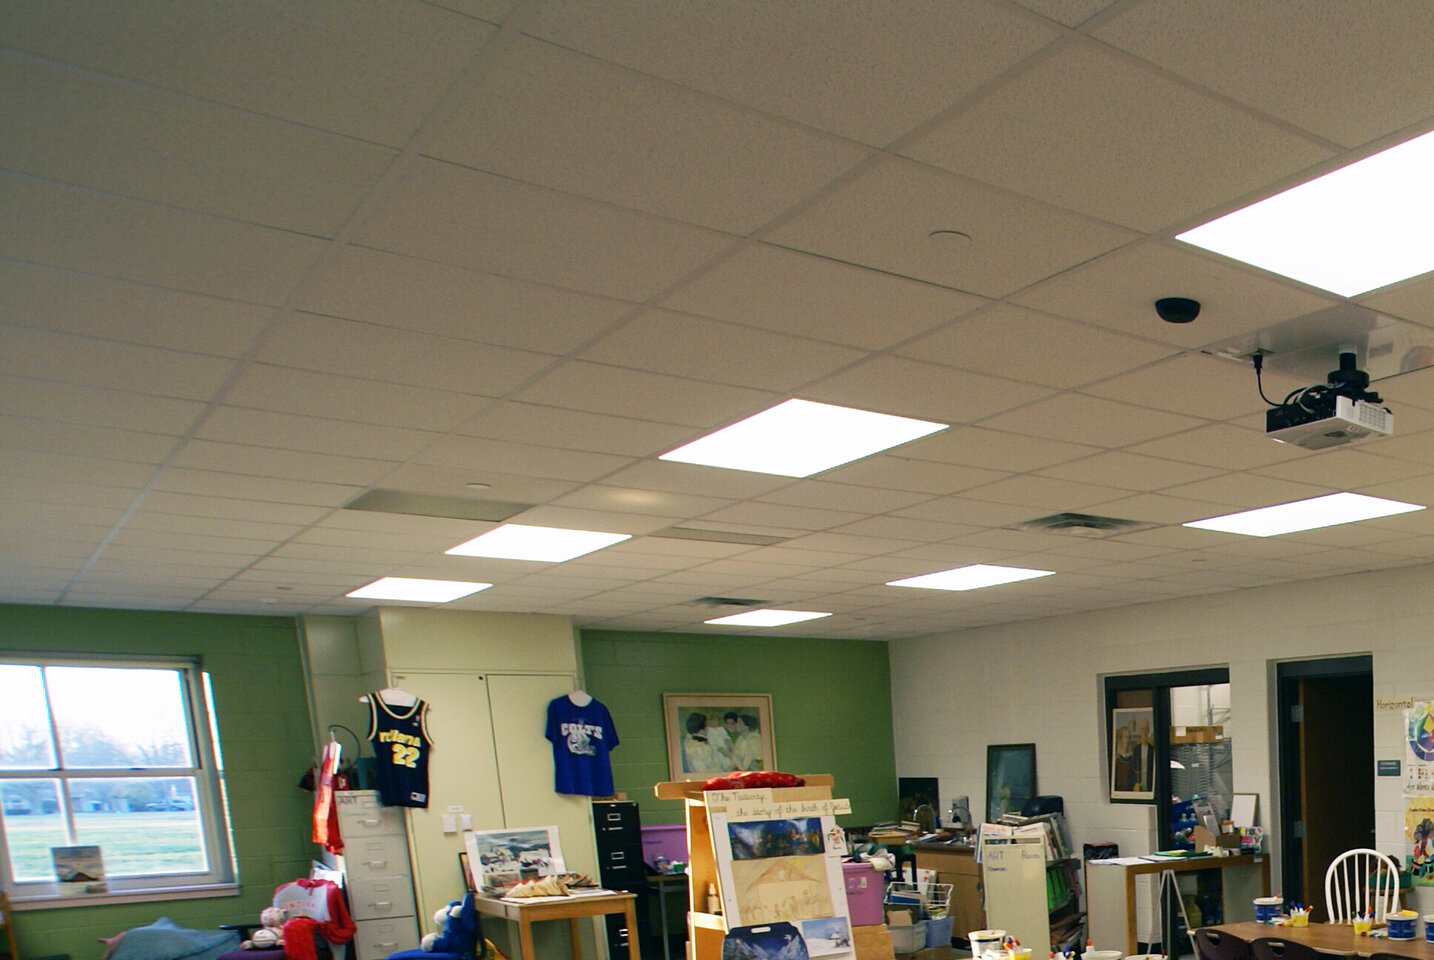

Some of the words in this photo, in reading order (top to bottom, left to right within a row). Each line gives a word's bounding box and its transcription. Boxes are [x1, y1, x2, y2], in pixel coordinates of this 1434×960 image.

[1376, 698, 1413, 710] Horizontal
[561, 723, 603, 740] COLTS
[391, 743, 421, 769] 22
